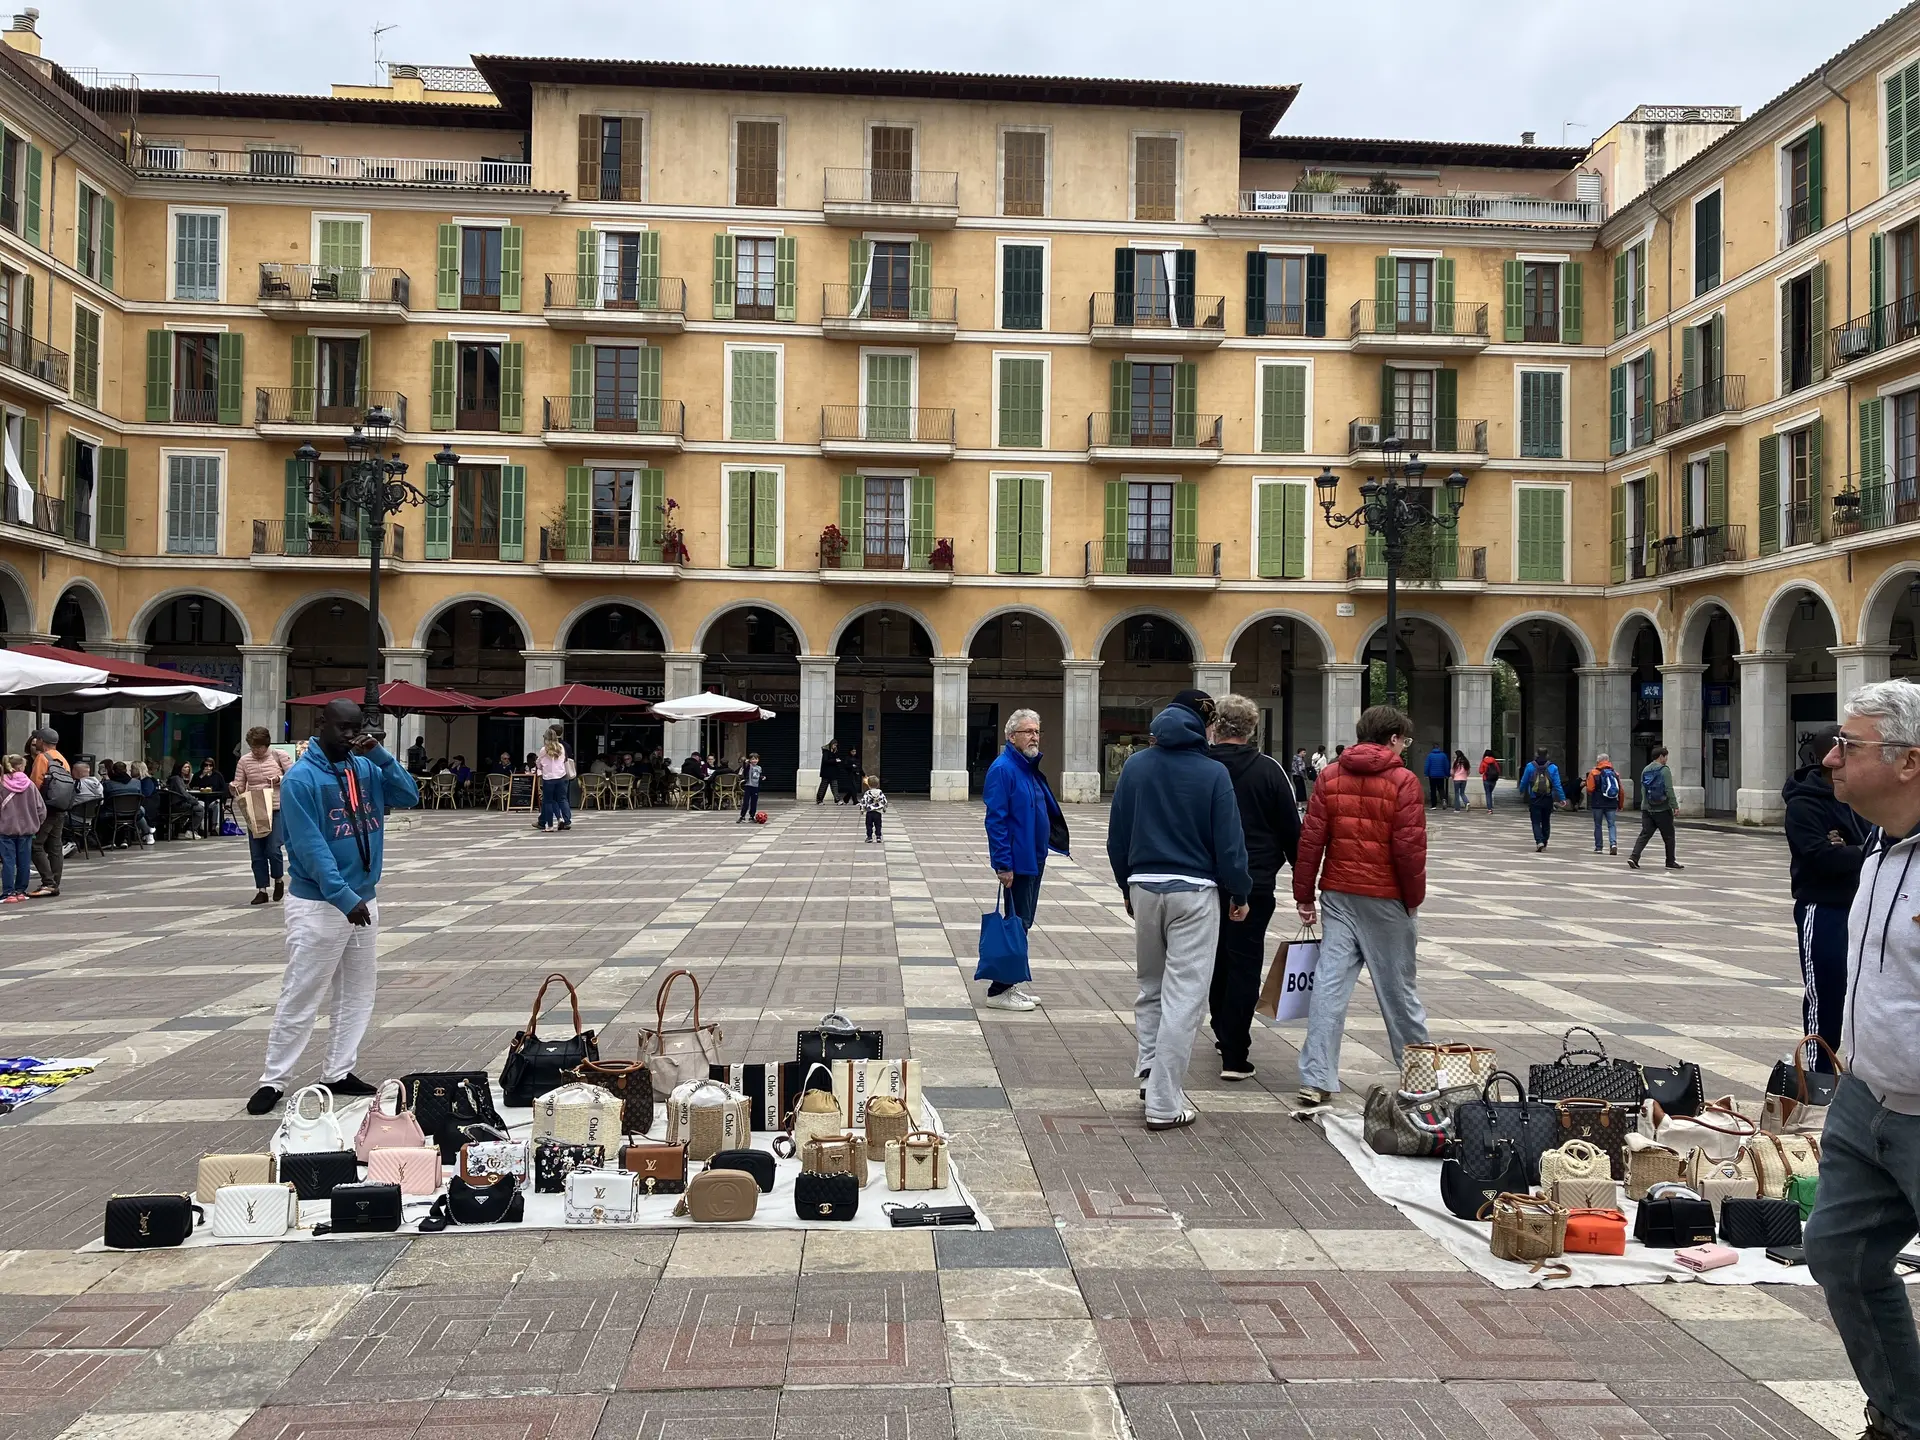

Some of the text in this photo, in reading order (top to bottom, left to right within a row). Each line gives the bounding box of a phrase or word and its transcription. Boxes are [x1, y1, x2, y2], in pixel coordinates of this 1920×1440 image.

[753, 693, 799, 703] CONTRO
[767, 1074, 777, 1097] Chloé
[856, 1070, 865, 1093] Chloé
[890, 1071, 899, 1093] Chloé
[680, 1102, 688, 1125] Chloé
[725, 1113, 734, 1137] Chloé
[767, 1105, 777, 1127] Chloé
[588, 1117, 599, 1141] Chloé
